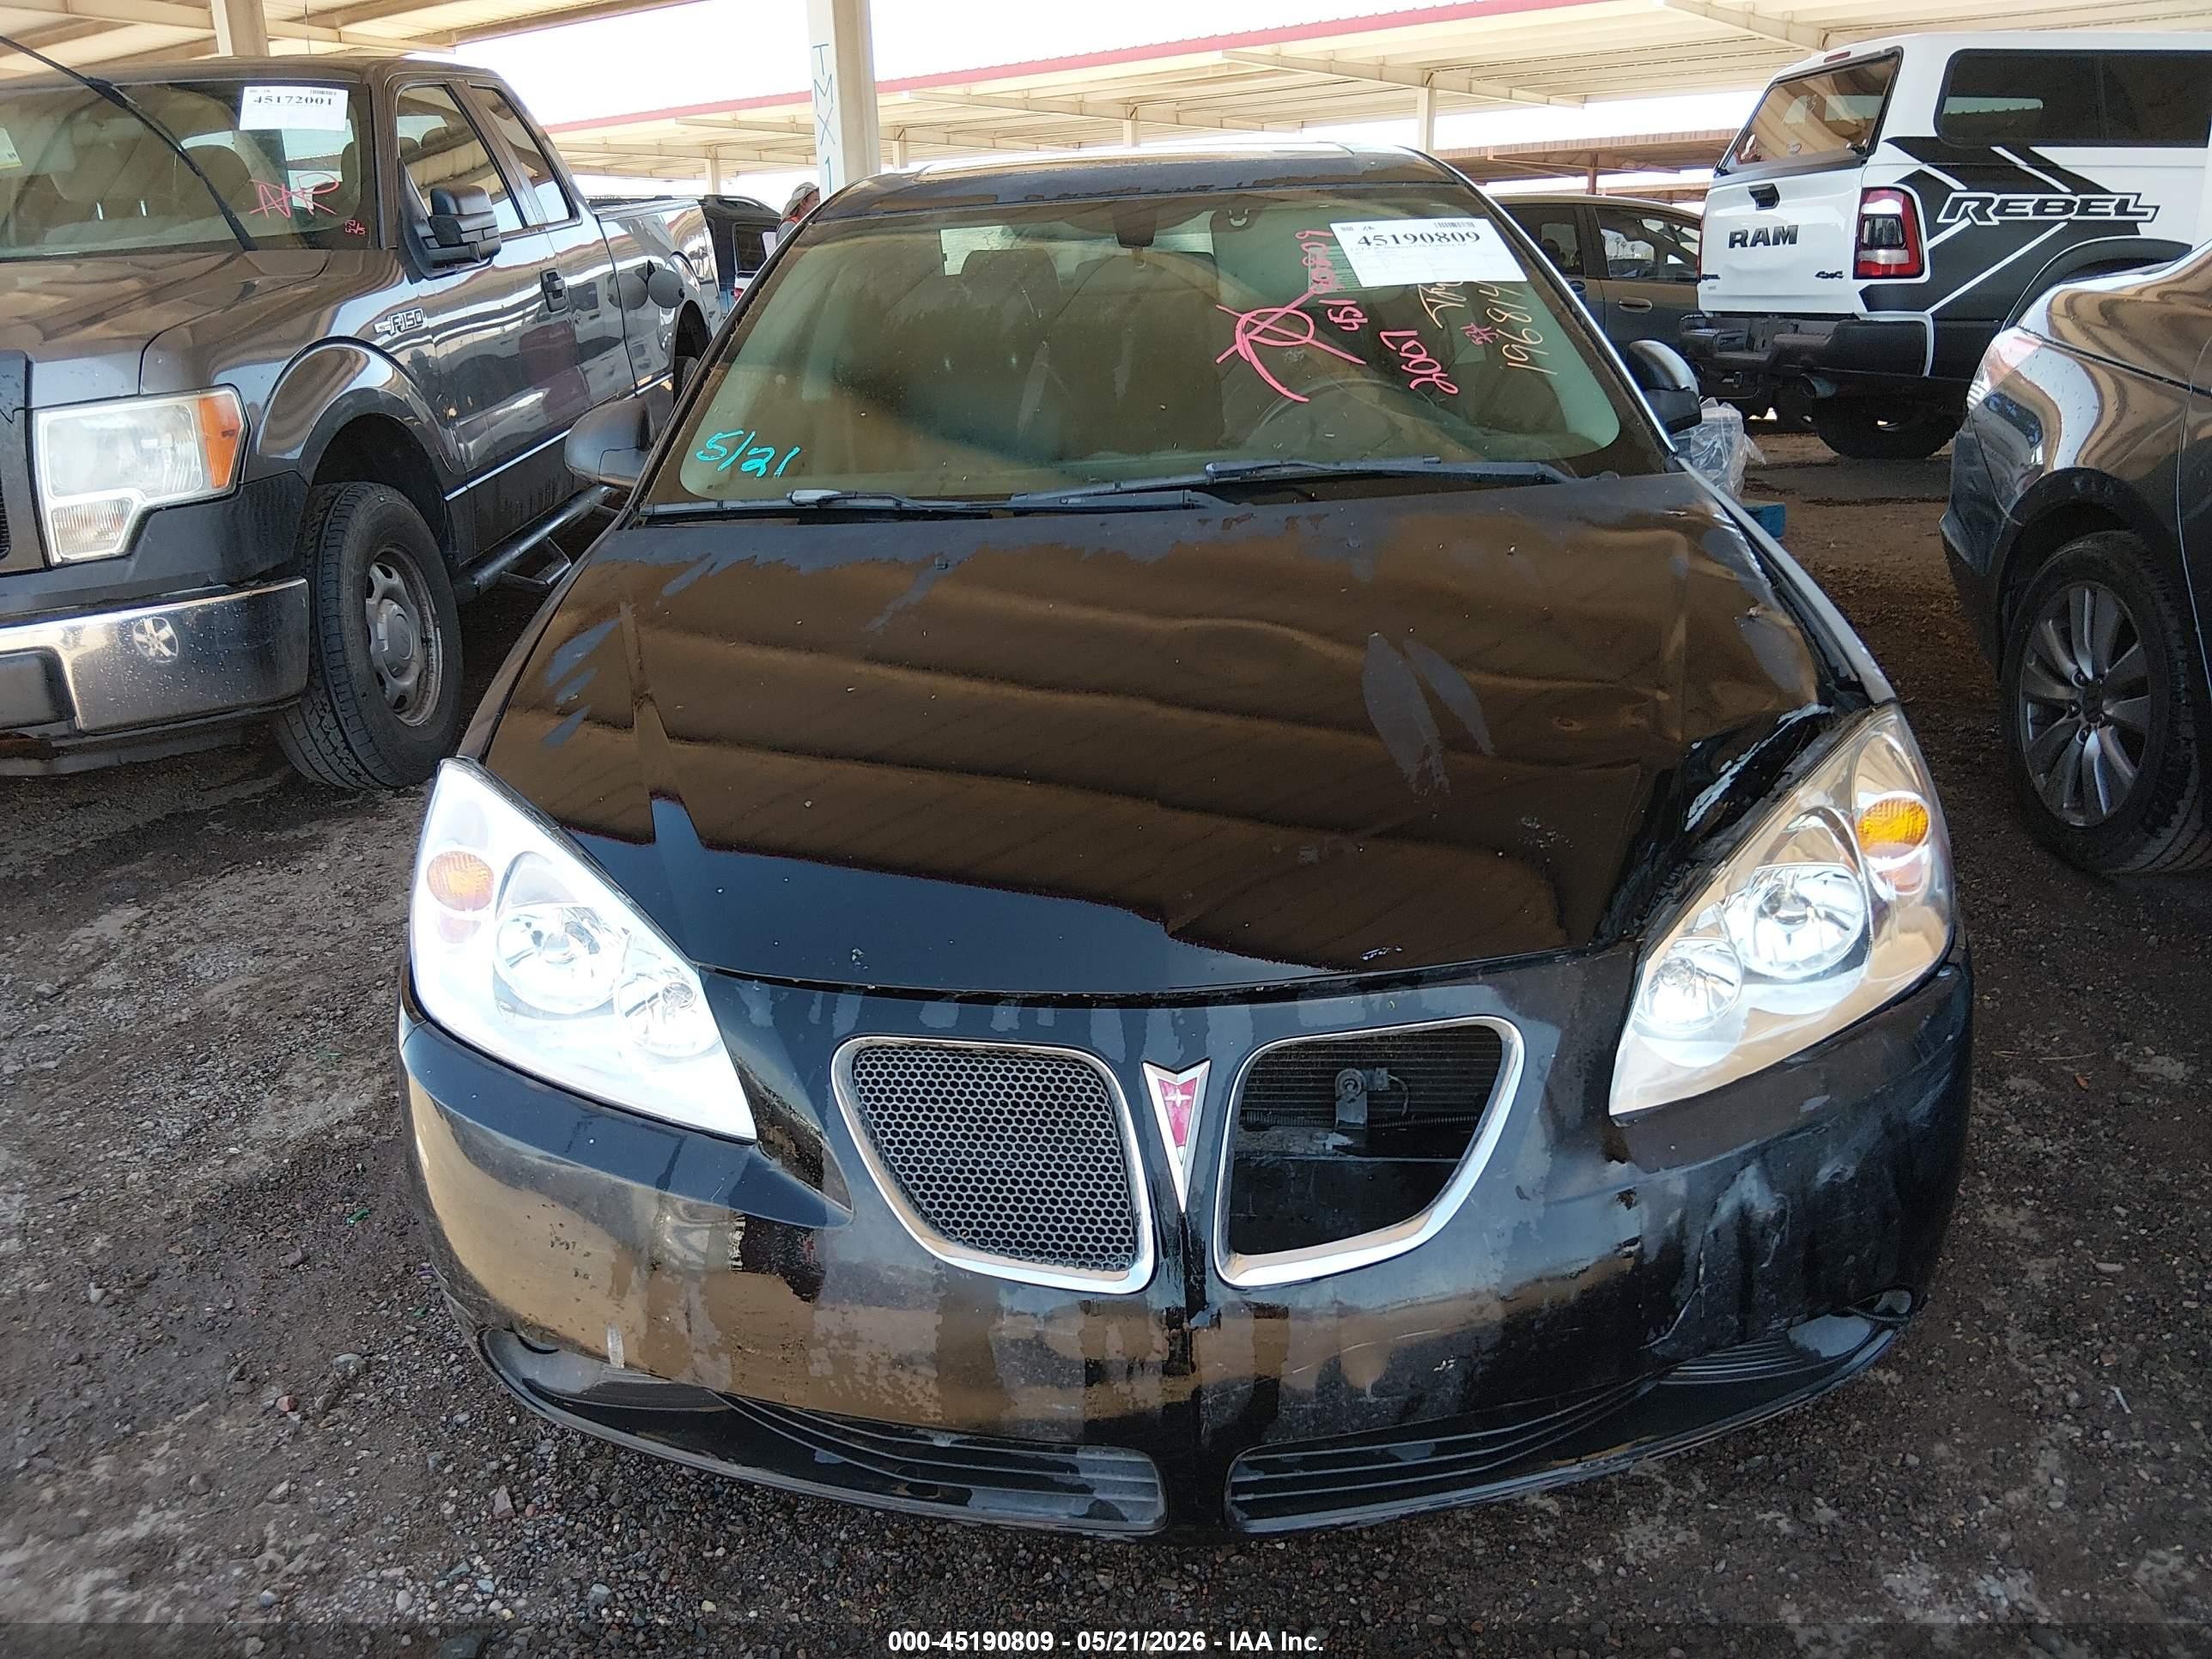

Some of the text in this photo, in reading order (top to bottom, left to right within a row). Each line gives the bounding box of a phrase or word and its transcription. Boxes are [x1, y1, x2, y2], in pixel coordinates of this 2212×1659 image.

[253, 95, 332, 106] 45172001
[1936, 191, 2160, 225] REBEL
[1357, 230, 1481, 247] 45190809
[1729, 224, 1800, 249] RAM
[1379, 329, 1460, 395] 2007
[696, 429, 802, 478] 5/21
